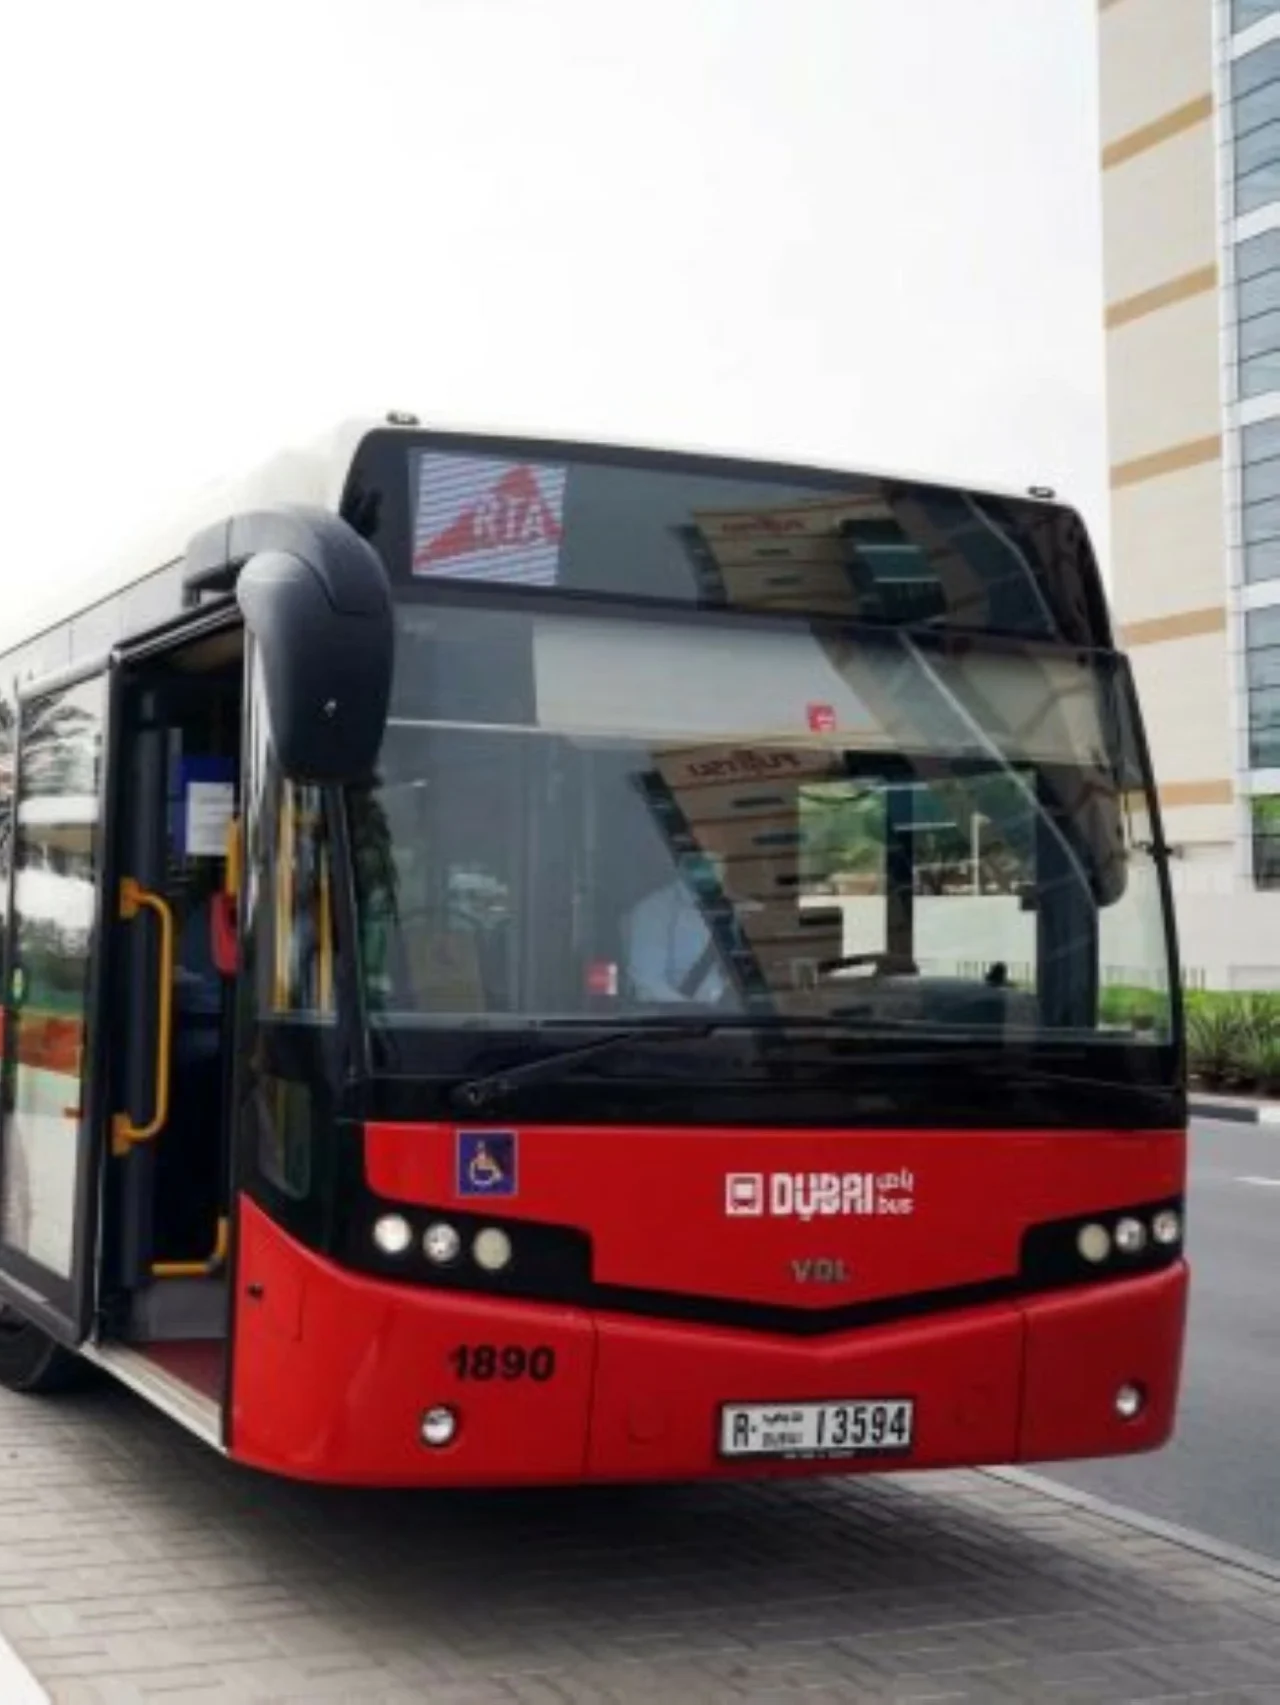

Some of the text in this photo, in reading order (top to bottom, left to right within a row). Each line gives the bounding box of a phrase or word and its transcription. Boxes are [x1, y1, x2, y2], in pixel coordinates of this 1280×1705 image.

[771, 1173, 873, 1221] DUBAI
[879, 1197, 913, 1214] bus
[449, 1343, 555, 1382] 1890
[816, 1405, 906, 1444] 13594
